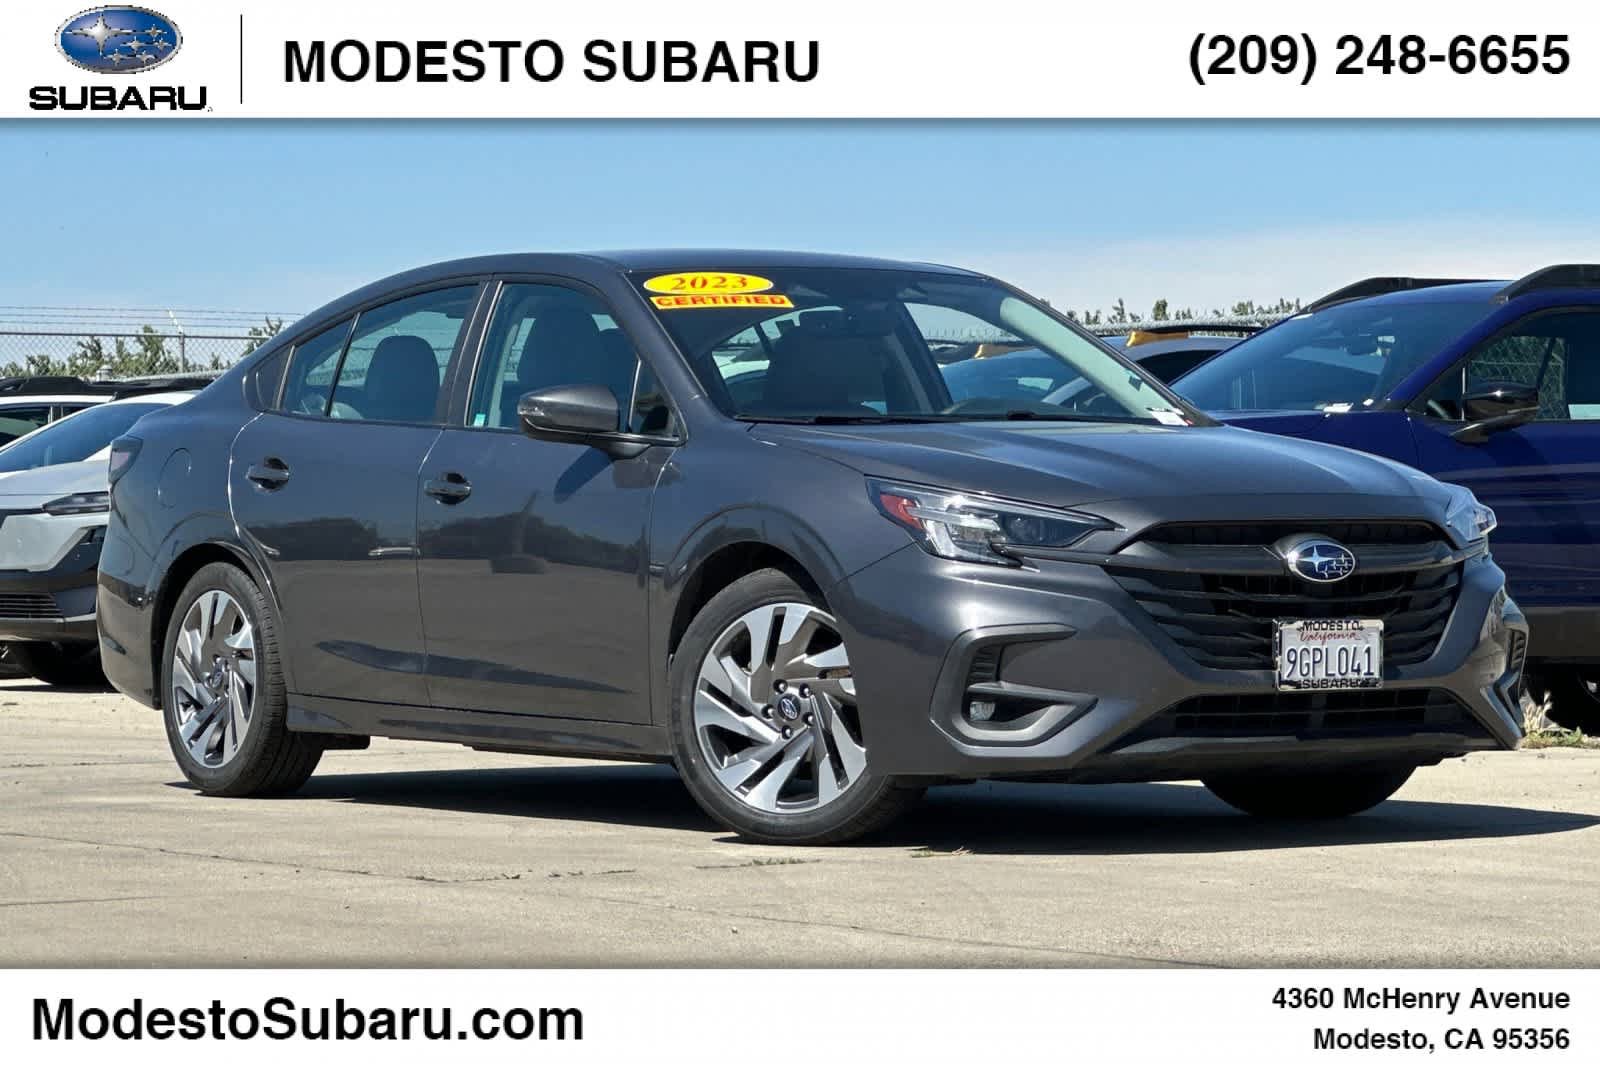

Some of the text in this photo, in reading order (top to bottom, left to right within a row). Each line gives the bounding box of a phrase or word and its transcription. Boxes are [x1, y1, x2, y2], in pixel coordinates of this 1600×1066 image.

[671, 276, 748, 291] 2023
[655, 294, 785, 306] CERTIFIED
[1302, 620, 1360, 631] MODESTO
[1300, 631, 1361, 645] California
[1286, 646, 1374, 678] 9GPL041
[1302, 679, 1366, 689] SUBARU
